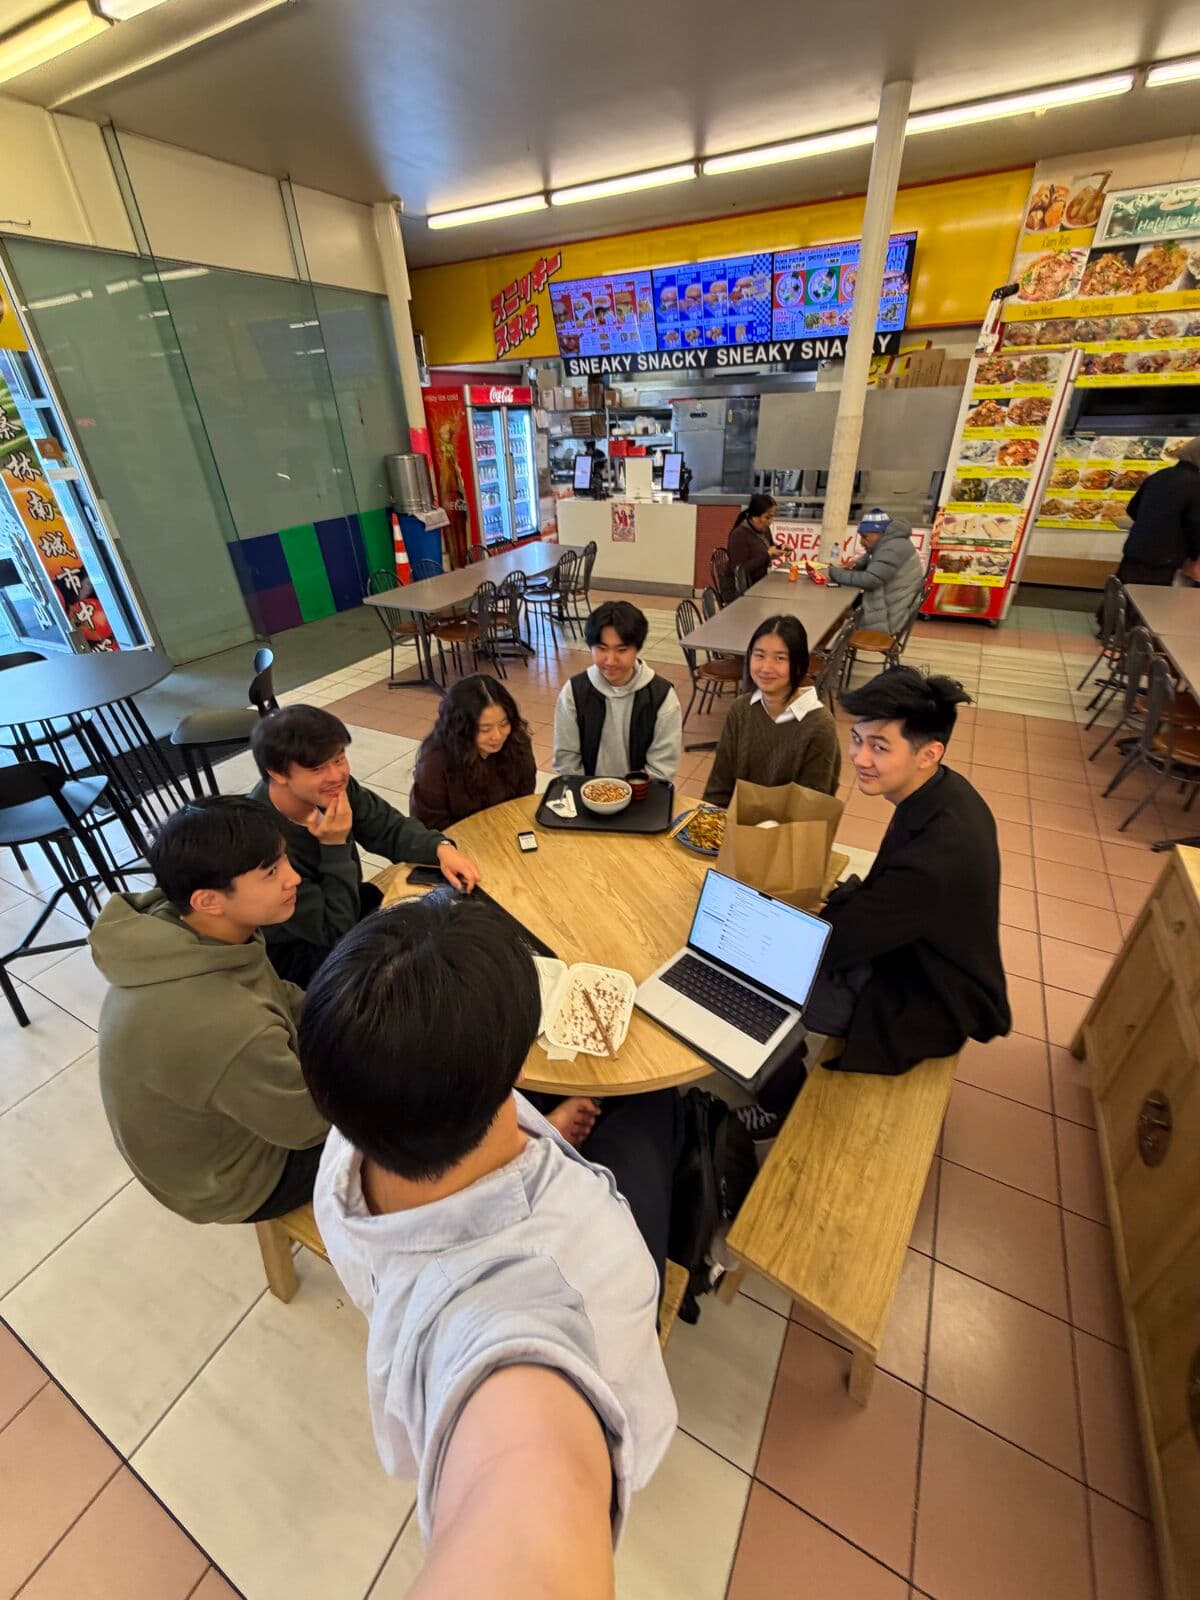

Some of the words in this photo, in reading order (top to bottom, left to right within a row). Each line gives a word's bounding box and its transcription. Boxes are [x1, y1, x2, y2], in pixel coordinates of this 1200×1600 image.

[887, 245, 908, 263] AKI
[569, 354, 632, 375] SNEAKY
[637, 350, 708, 371] SNACKY
[716, 341, 795, 366] SNEAKY
[801, 335, 891, 360] SNAY
[775, 532, 854, 552] SNEAY
